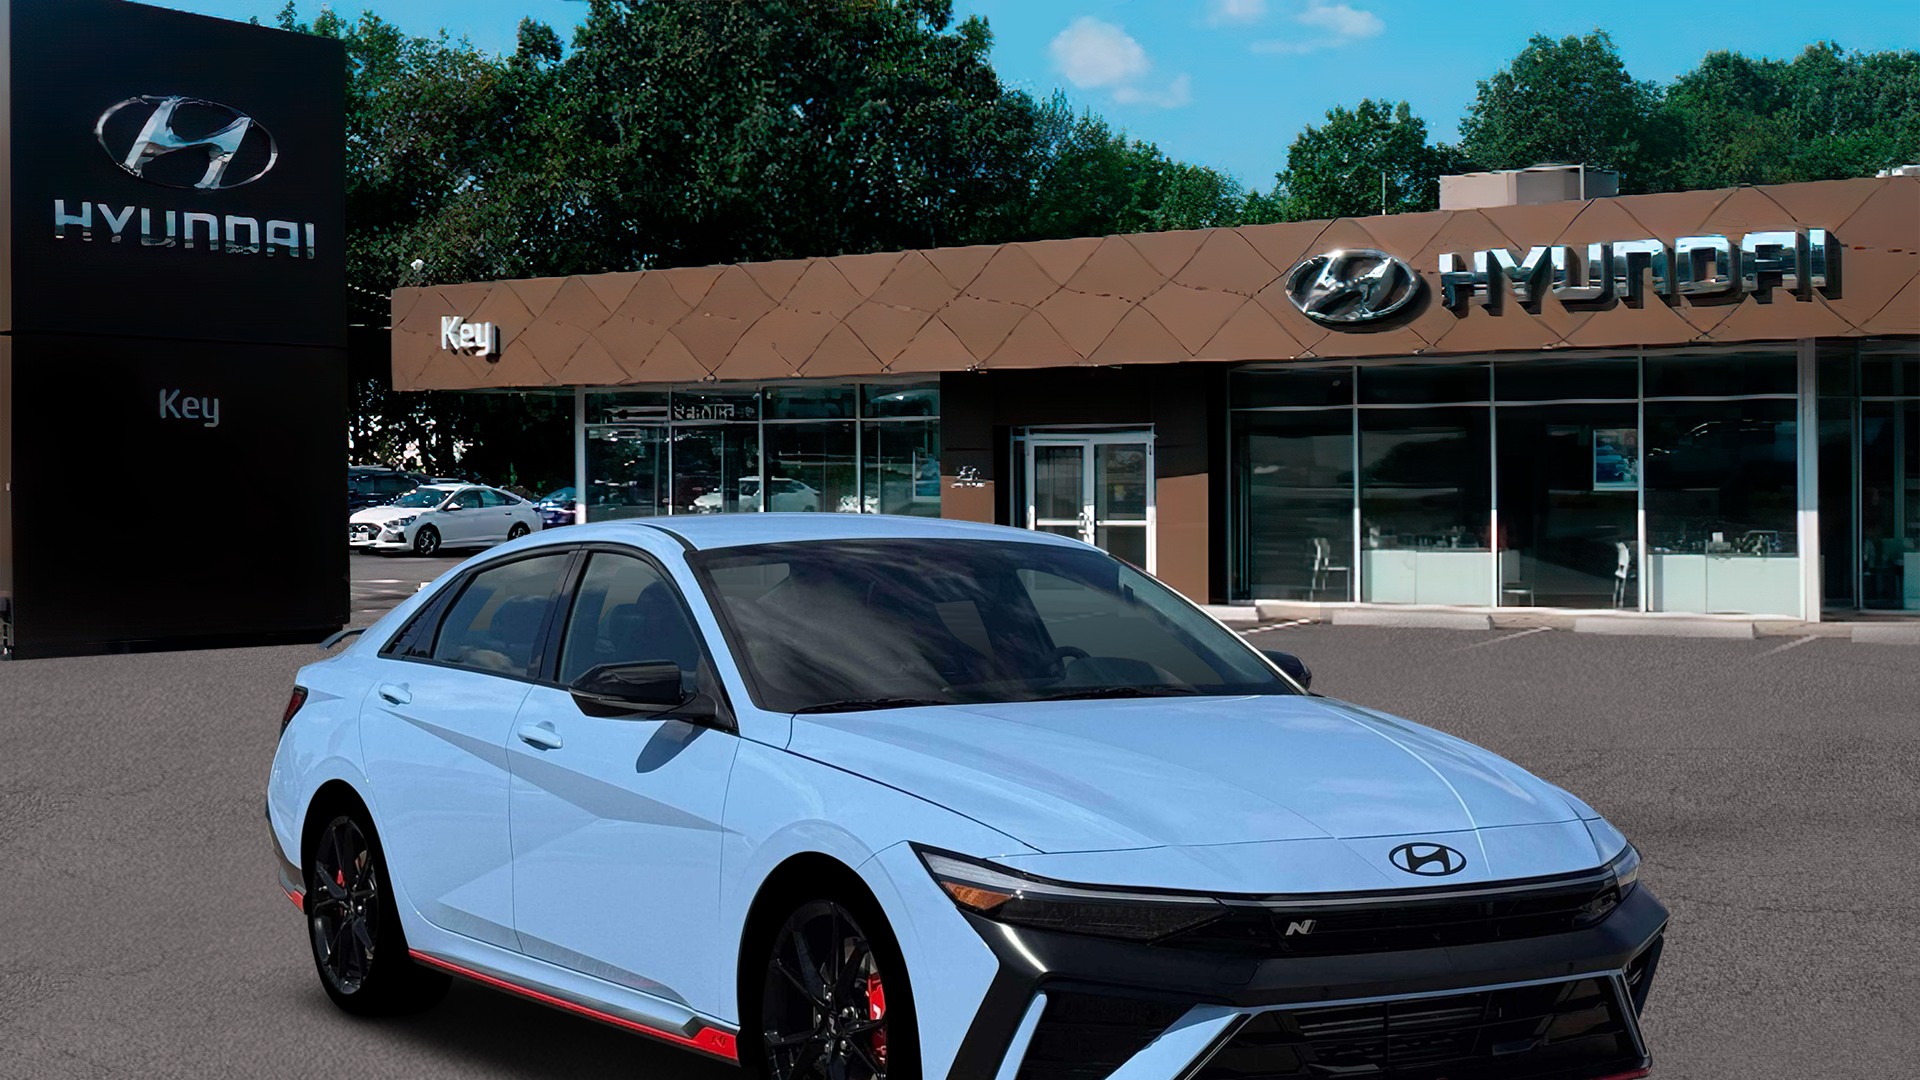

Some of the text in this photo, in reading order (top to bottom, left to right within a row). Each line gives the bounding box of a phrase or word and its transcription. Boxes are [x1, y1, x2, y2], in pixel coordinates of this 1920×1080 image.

[54, 199, 315, 260] HYUNDAI
[1438, 229, 1840, 315] HYUNDAI
[441, 315, 492, 357] Key
[159, 388, 220, 428] Key
